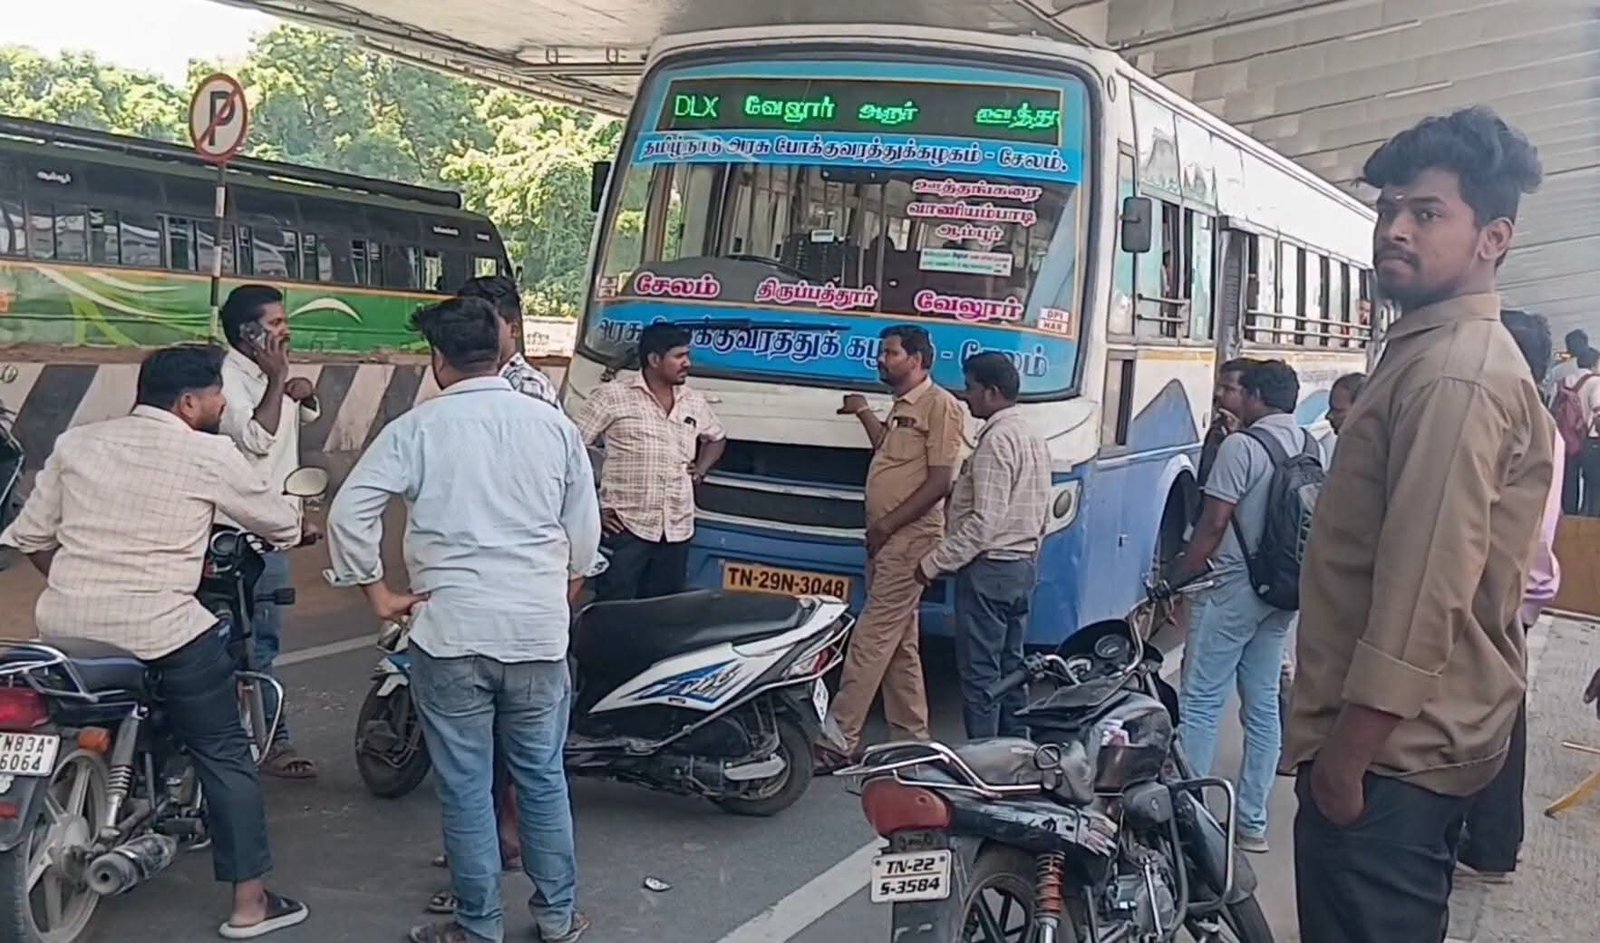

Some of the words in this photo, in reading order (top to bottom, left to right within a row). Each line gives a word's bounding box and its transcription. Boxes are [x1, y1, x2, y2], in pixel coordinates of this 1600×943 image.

[674, 95, 719, 118] DLX
[745, 95, 835, 122] வேலூர்
[640, 135, 723, 160] தமிழ்நாடு
[729, 135, 770, 156] அரசு
[912, 178, 1043, 202] ஊத்தங்கரை
[907, 201, 1038, 228] வாணியம்பாடி
[634, 271, 720, 298] சேலம்
[754, 276, 879, 311] திருப்பத்தூர்
[914, 288, 1024, 322] வேலூர்
[727, 566, 846, 599] TN-29N-3048
[0, 735, 46, 753] N83A
[886, 857, 936, 874] TN-22
[880, 877, 941, 896] S-3584
